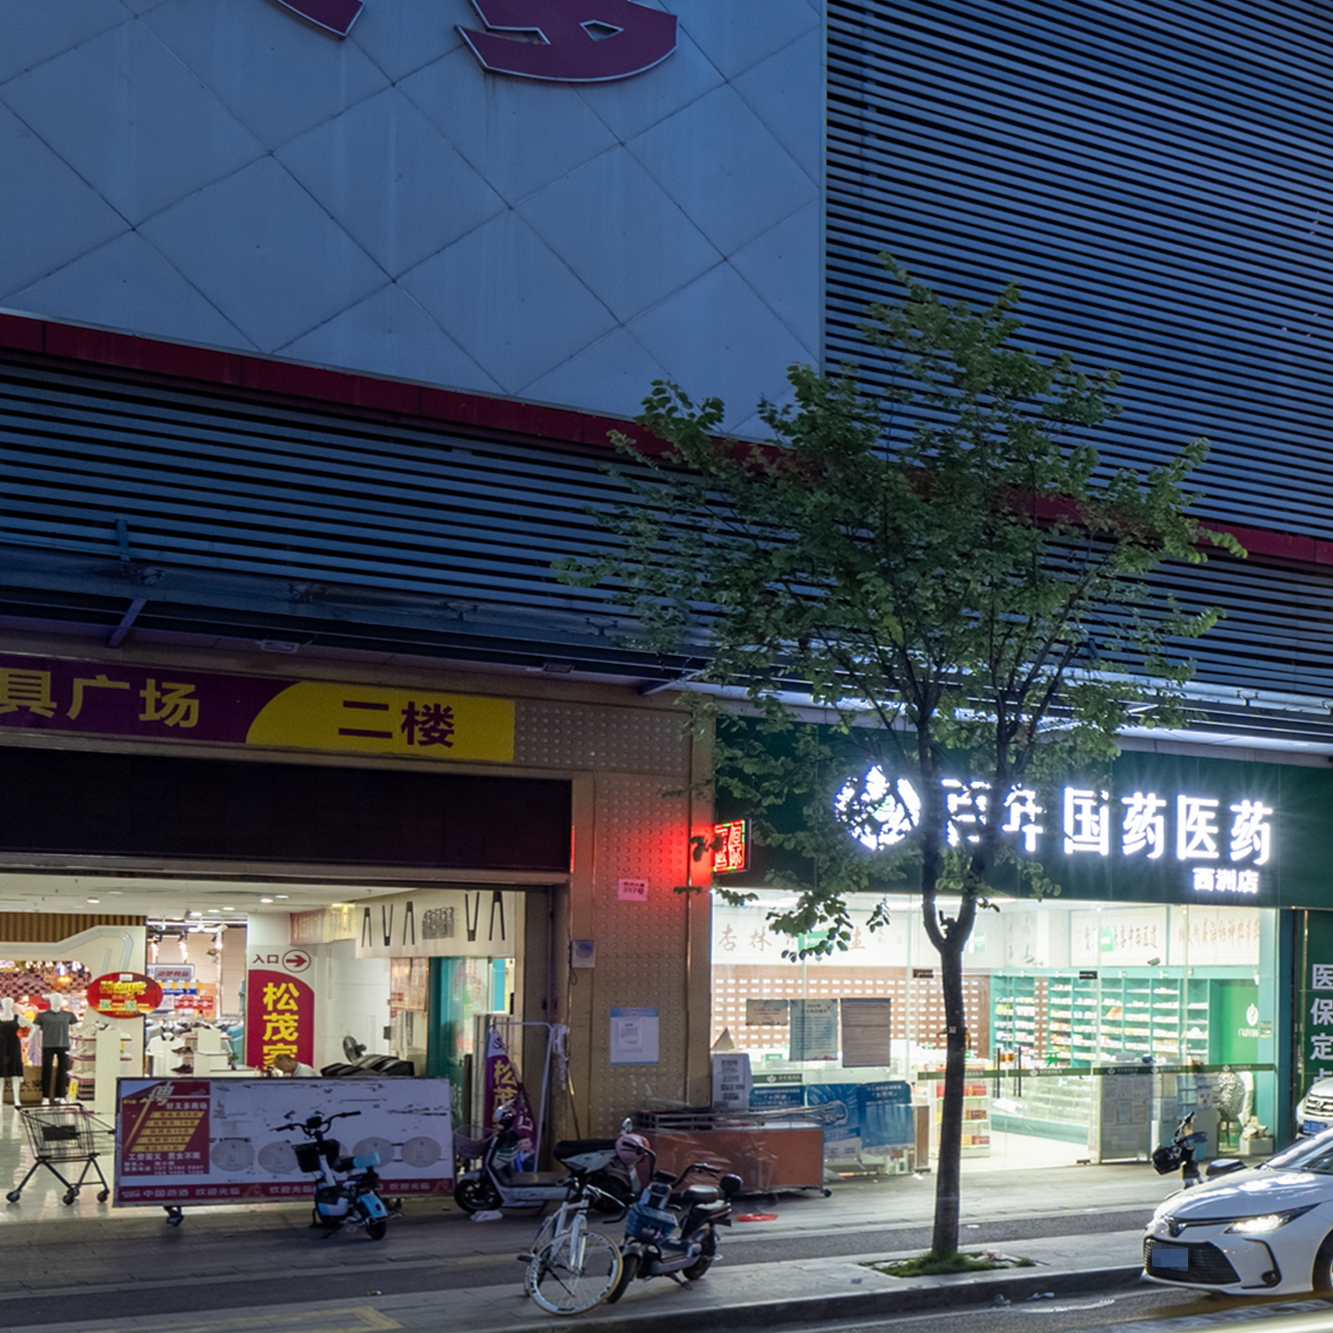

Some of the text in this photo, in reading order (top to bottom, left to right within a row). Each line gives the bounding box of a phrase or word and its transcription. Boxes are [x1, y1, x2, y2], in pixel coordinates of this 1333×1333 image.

[0, 668, 200, 728] 具广场
[338, 699, 455, 749] 二楼
[1192, 867, 1260, 894] 西洲店
[252, 954, 279, 964] 入口
